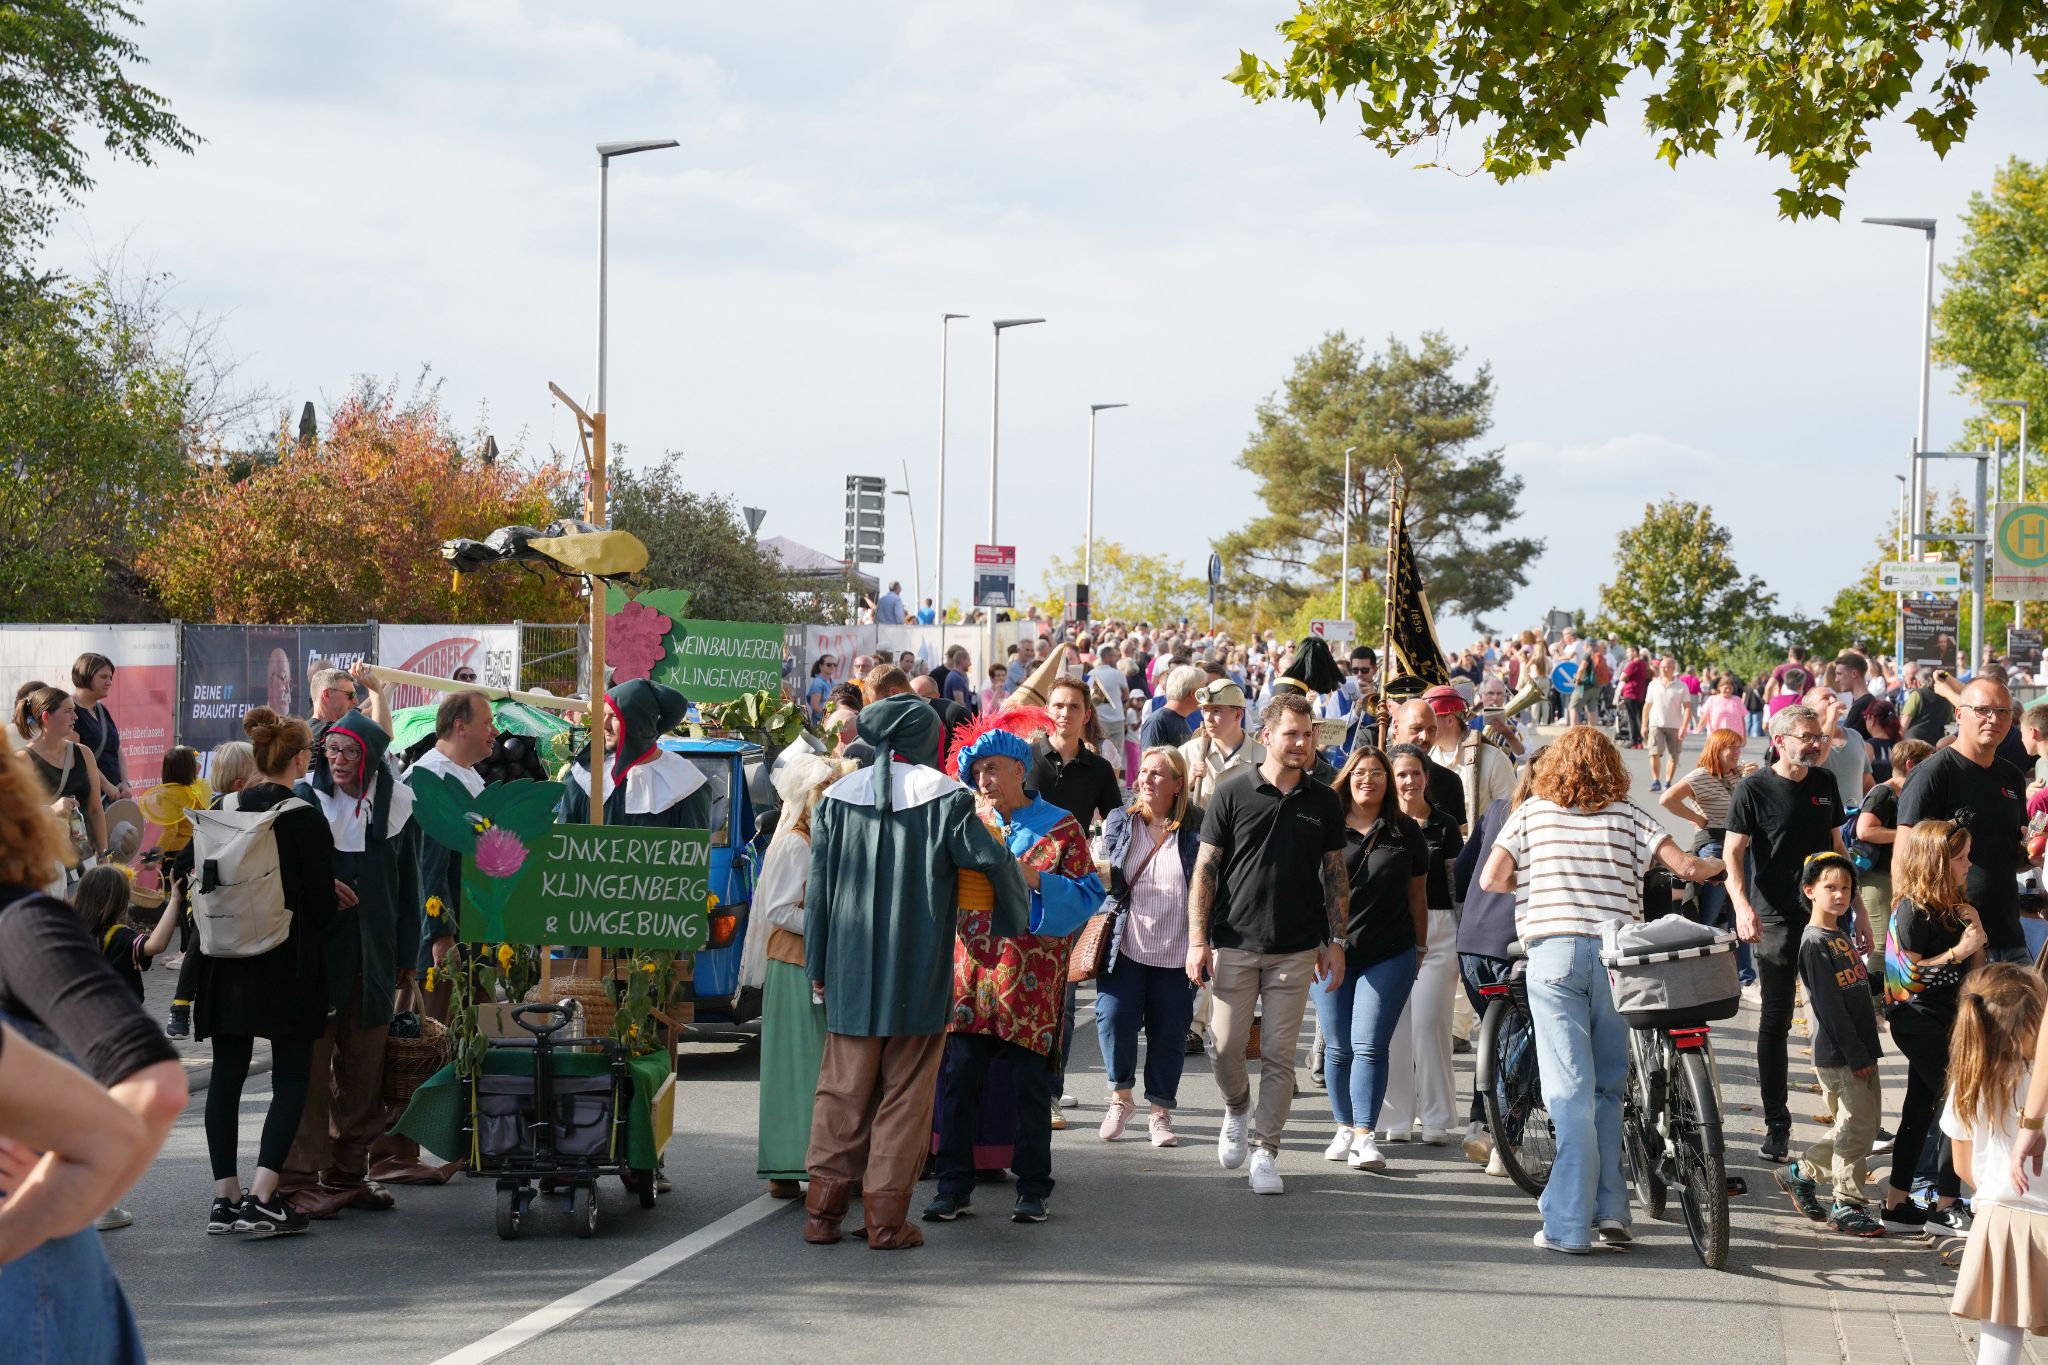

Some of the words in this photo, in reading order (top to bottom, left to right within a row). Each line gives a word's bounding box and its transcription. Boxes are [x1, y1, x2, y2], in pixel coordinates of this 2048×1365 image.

[2018, 519, 2045, 554] H
[671, 633, 784, 660] WEINBAUVEREIN
[670, 666, 778, 690] KLINGENBERG
[193, 685, 221, 700] DEINE
[223, 685, 234, 700] IT
[192, 703, 237, 719] BRAUCHT
[541, 871, 708, 902] KLINGENBERG
[545, 915, 558, 934] &
[569, 910, 699, 938] UMGEBUNG
[1835, 963, 1868, 987] EDG
